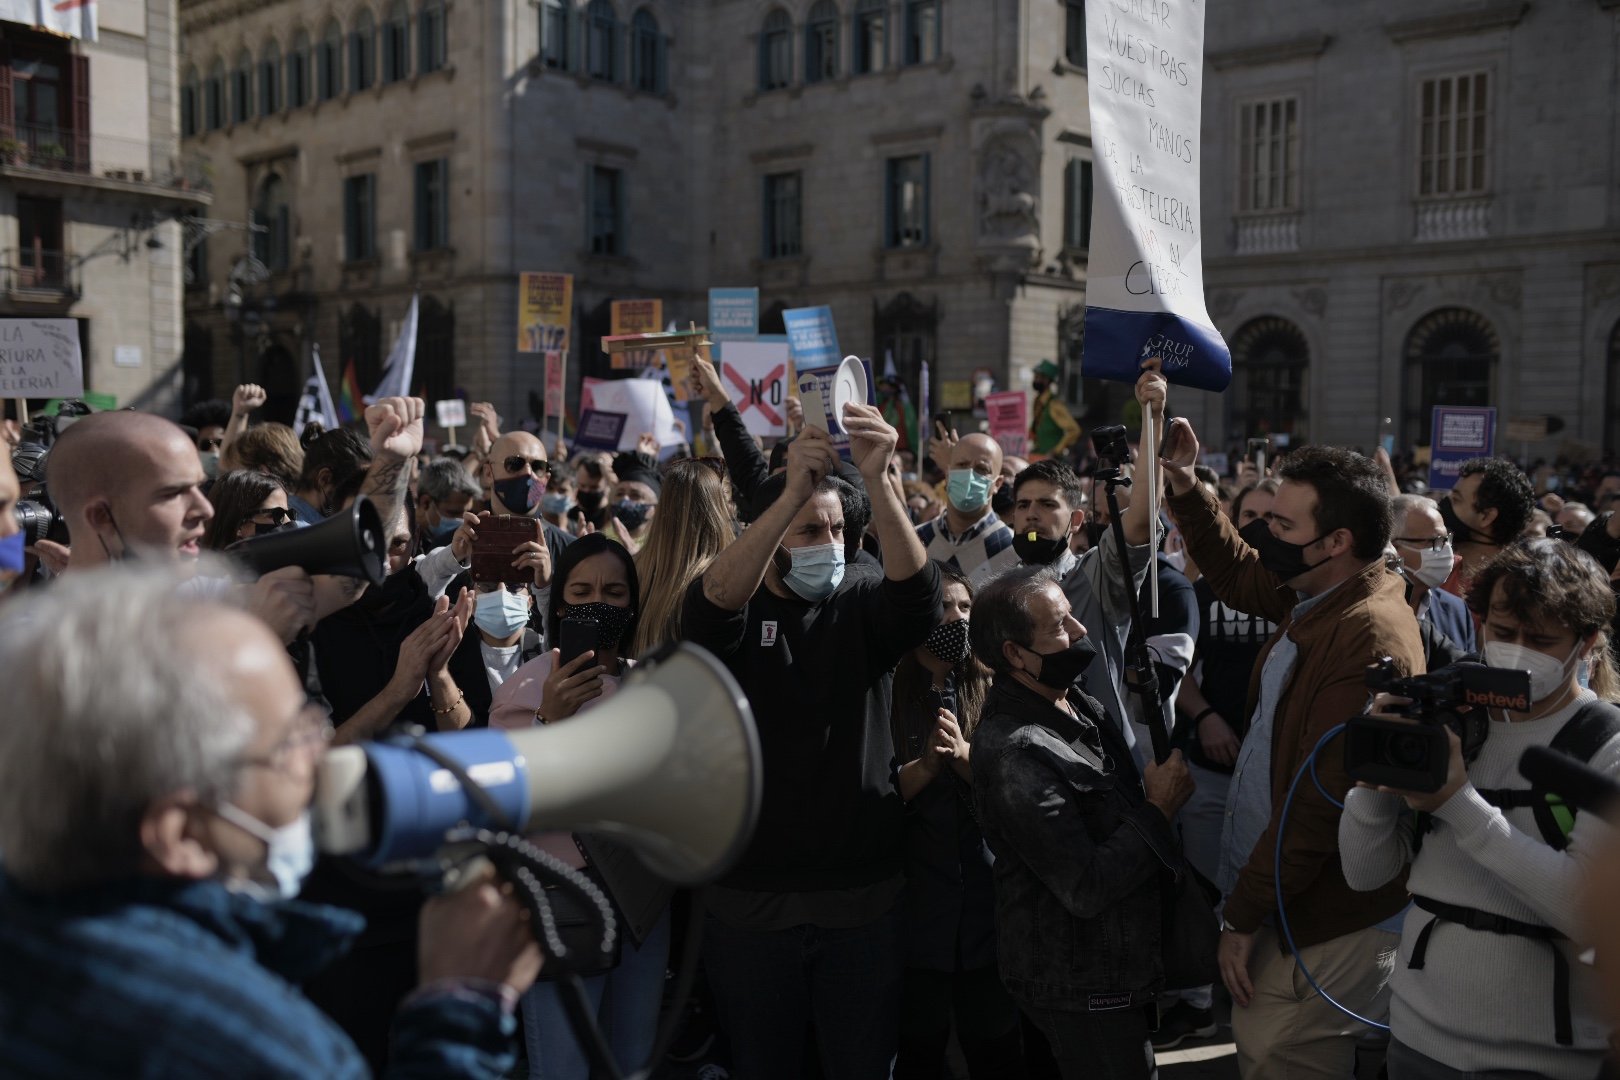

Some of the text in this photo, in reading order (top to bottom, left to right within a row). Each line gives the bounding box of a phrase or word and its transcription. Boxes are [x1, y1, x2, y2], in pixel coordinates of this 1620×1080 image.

[1104, 13, 1188, 87] VUESTRAS
[1099, 65, 1155, 107] SUCIAS
[1149, 118, 1192, 164] MANOS
[1129, 152, 1144, 175] LA
[3, 326, 24, 342] LA
[1466, 689, 1527, 709] betevé
